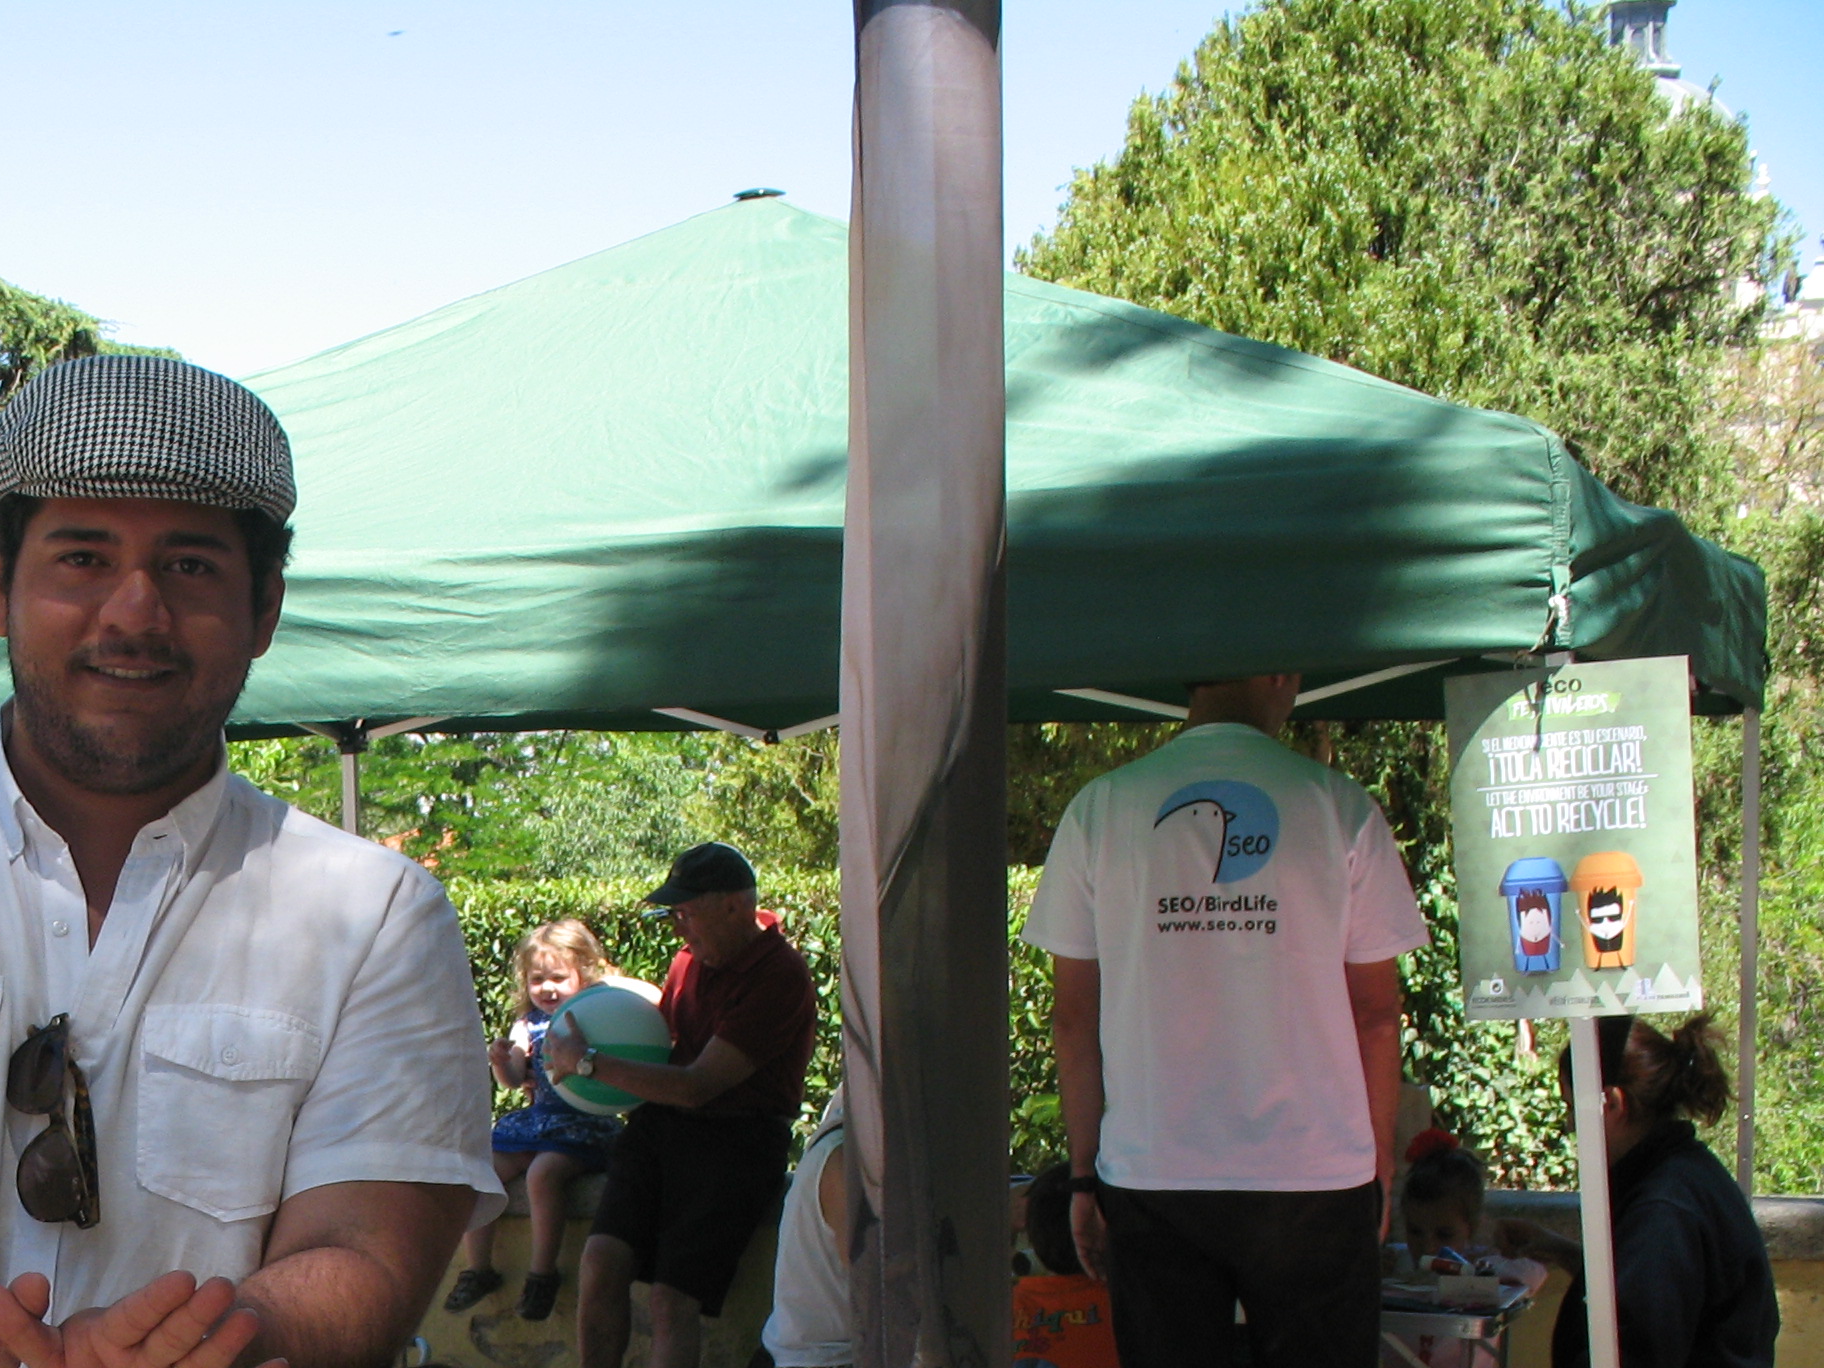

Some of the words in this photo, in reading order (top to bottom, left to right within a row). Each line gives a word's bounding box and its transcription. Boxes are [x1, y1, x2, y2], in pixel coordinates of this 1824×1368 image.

[1491, 737, 1502, 752] EL
[1569, 730, 1581, 746] ES
[1582, 728, 1595, 745] TU
[1547, 742, 1643, 779] RECICLAR!
[1486, 792, 1500, 807] LET
[1502, 790, 1518, 805] THE
[1577, 784, 1590, 799] BE
[1591, 782, 1614, 799] YOUR
[1491, 806, 1526, 838] ACT
[1526, 803, 1552, 836] TO
[1556, 795, 1647, 834] RECYCLE!
[1158, 896, 1277, 914] SEO/BirdLife
[1157, 918, 1277, 935] www.seo.org
